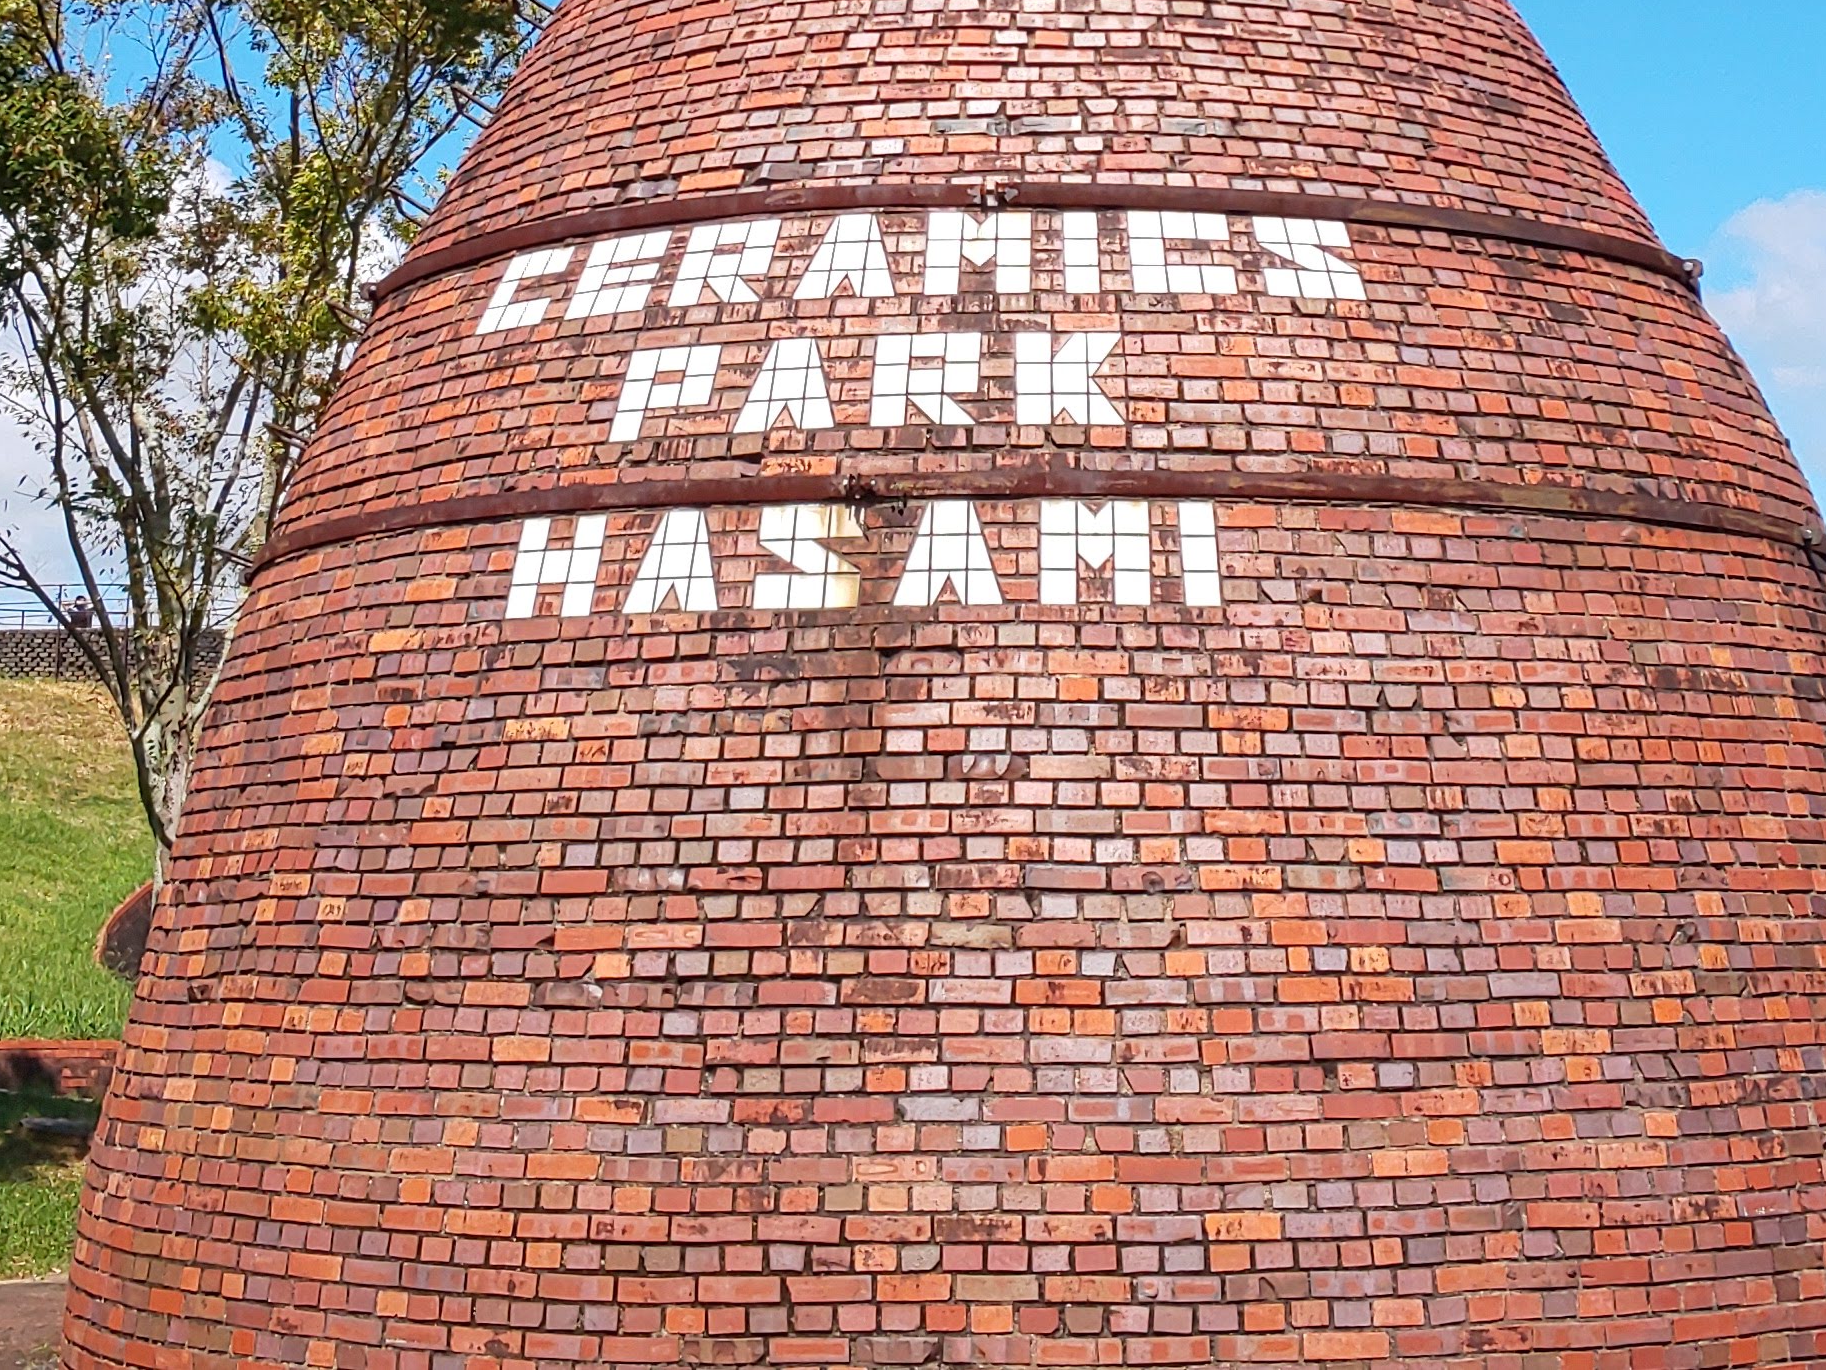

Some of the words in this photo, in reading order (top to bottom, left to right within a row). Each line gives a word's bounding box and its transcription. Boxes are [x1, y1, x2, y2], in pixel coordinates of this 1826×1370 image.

[476, 210, 1367, 335] CERAMICS
[609, 331, 1126, 443] PARK
[504, 499, 1222, 619] HASAMI
